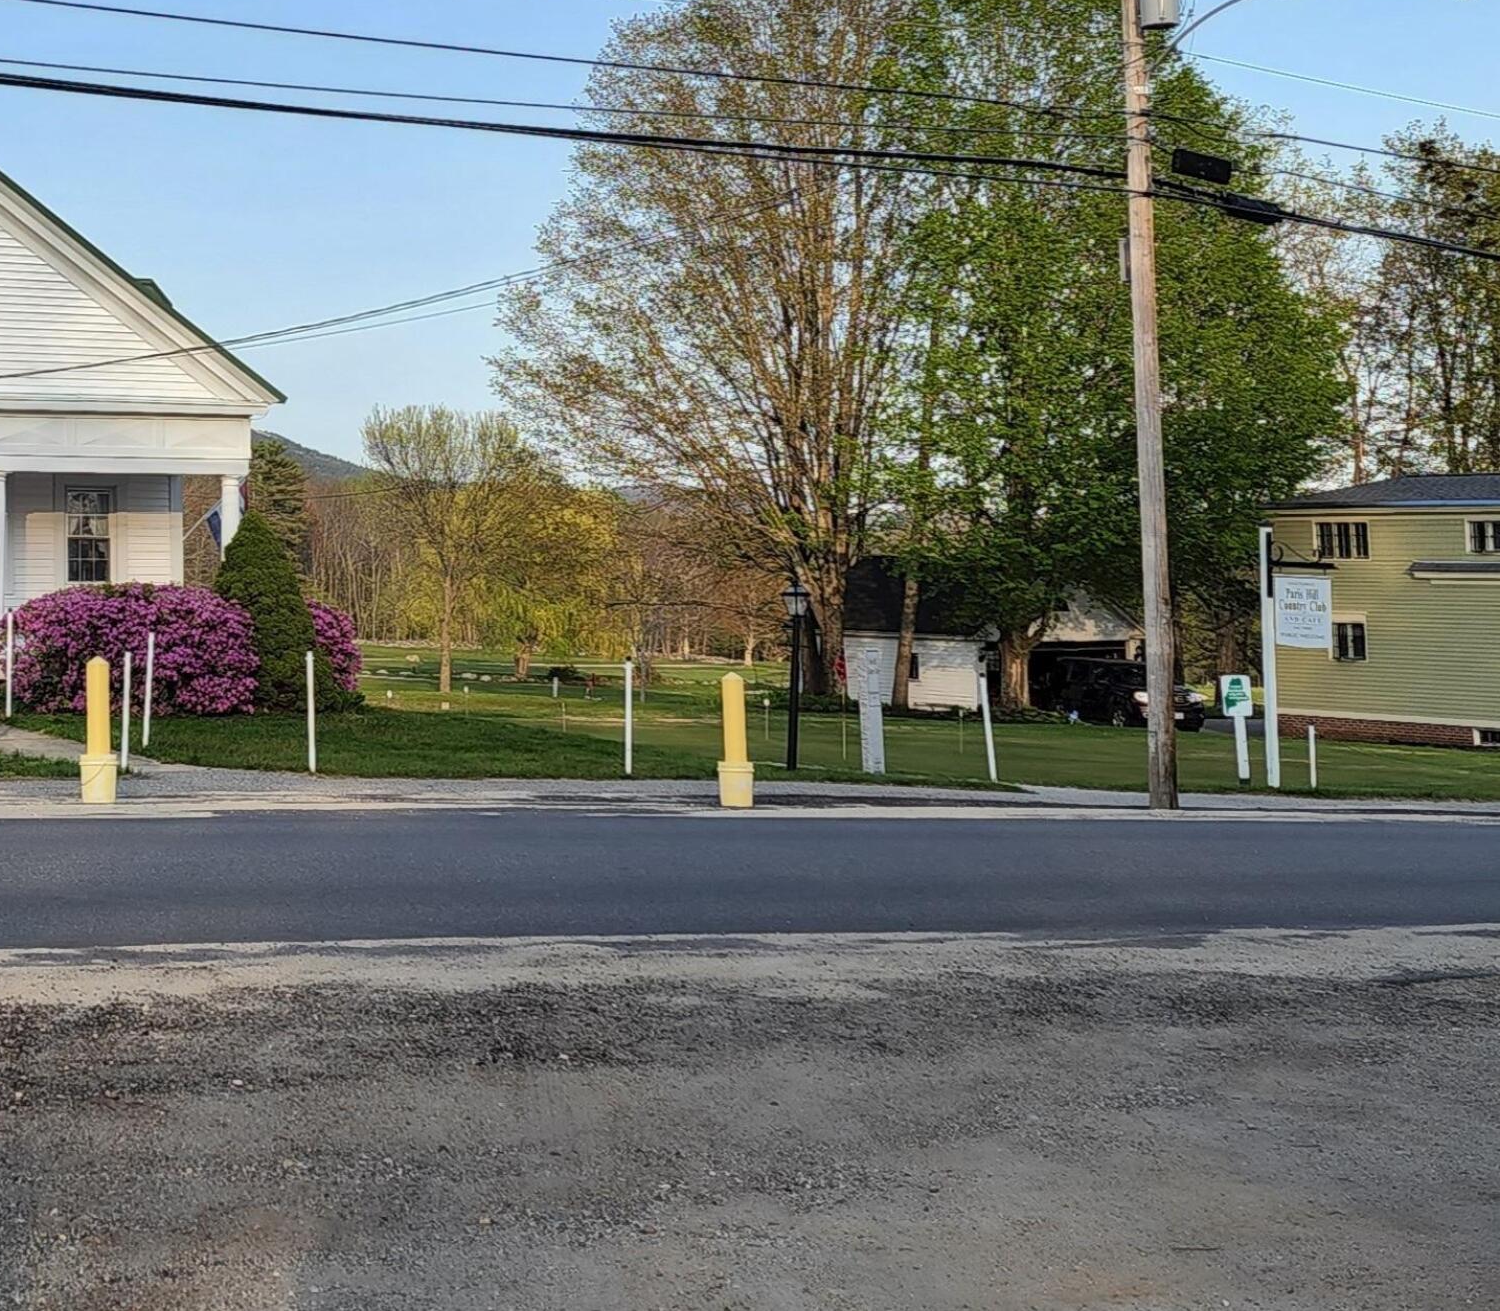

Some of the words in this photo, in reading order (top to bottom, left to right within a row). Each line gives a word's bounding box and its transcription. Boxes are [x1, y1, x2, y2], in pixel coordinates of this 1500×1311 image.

[1285, 588, 1304, 599] Paris
[1279, 599, 1308, 611] Country
[1310, 600, 1327, 613] Club
